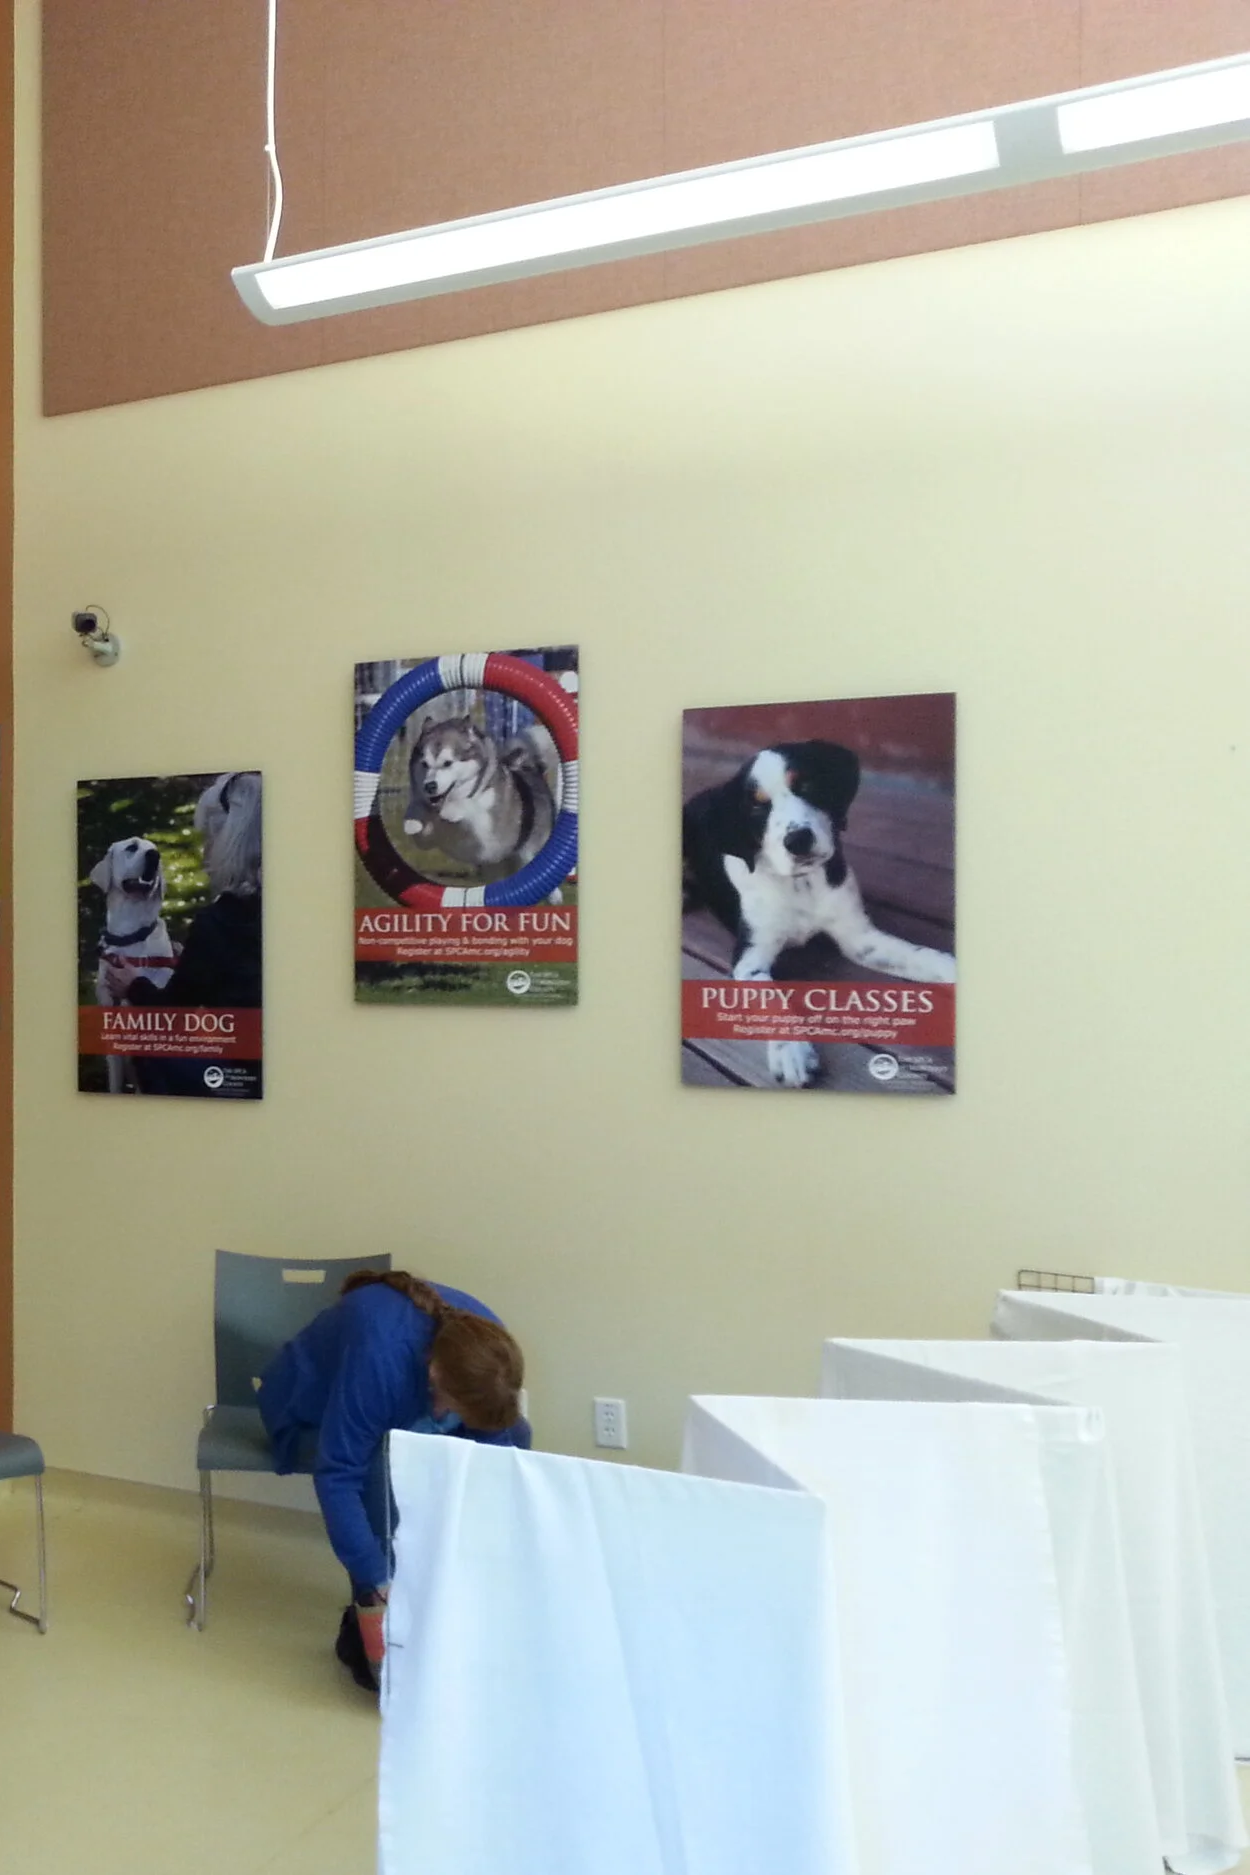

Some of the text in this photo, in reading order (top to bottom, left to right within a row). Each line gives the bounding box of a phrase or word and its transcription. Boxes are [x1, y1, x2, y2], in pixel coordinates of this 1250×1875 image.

[358, 912, 571, 933] AGILITY FOR FUN
[429, 936, 461, 947] playing
[510, 936, 529, 945] with
[532, 938, 552, 947] your
[554, 937, 573, 947] dog
[397, 947, 431, 957] Register
[433, 948, 443, 956] at
[701, 986, 934, 1014] PUPPY CLASSES
[102, 1012, 235, 1033] FAMILY DOG
[717, 1011, 916, 1028] Start your puppy off on the right paw
[733, 1023, 898, 1040] Register at SPCAmc.org/puppy
[113, 1042, 143, 1052] Register
[144, 1043, 152, 1052] at
